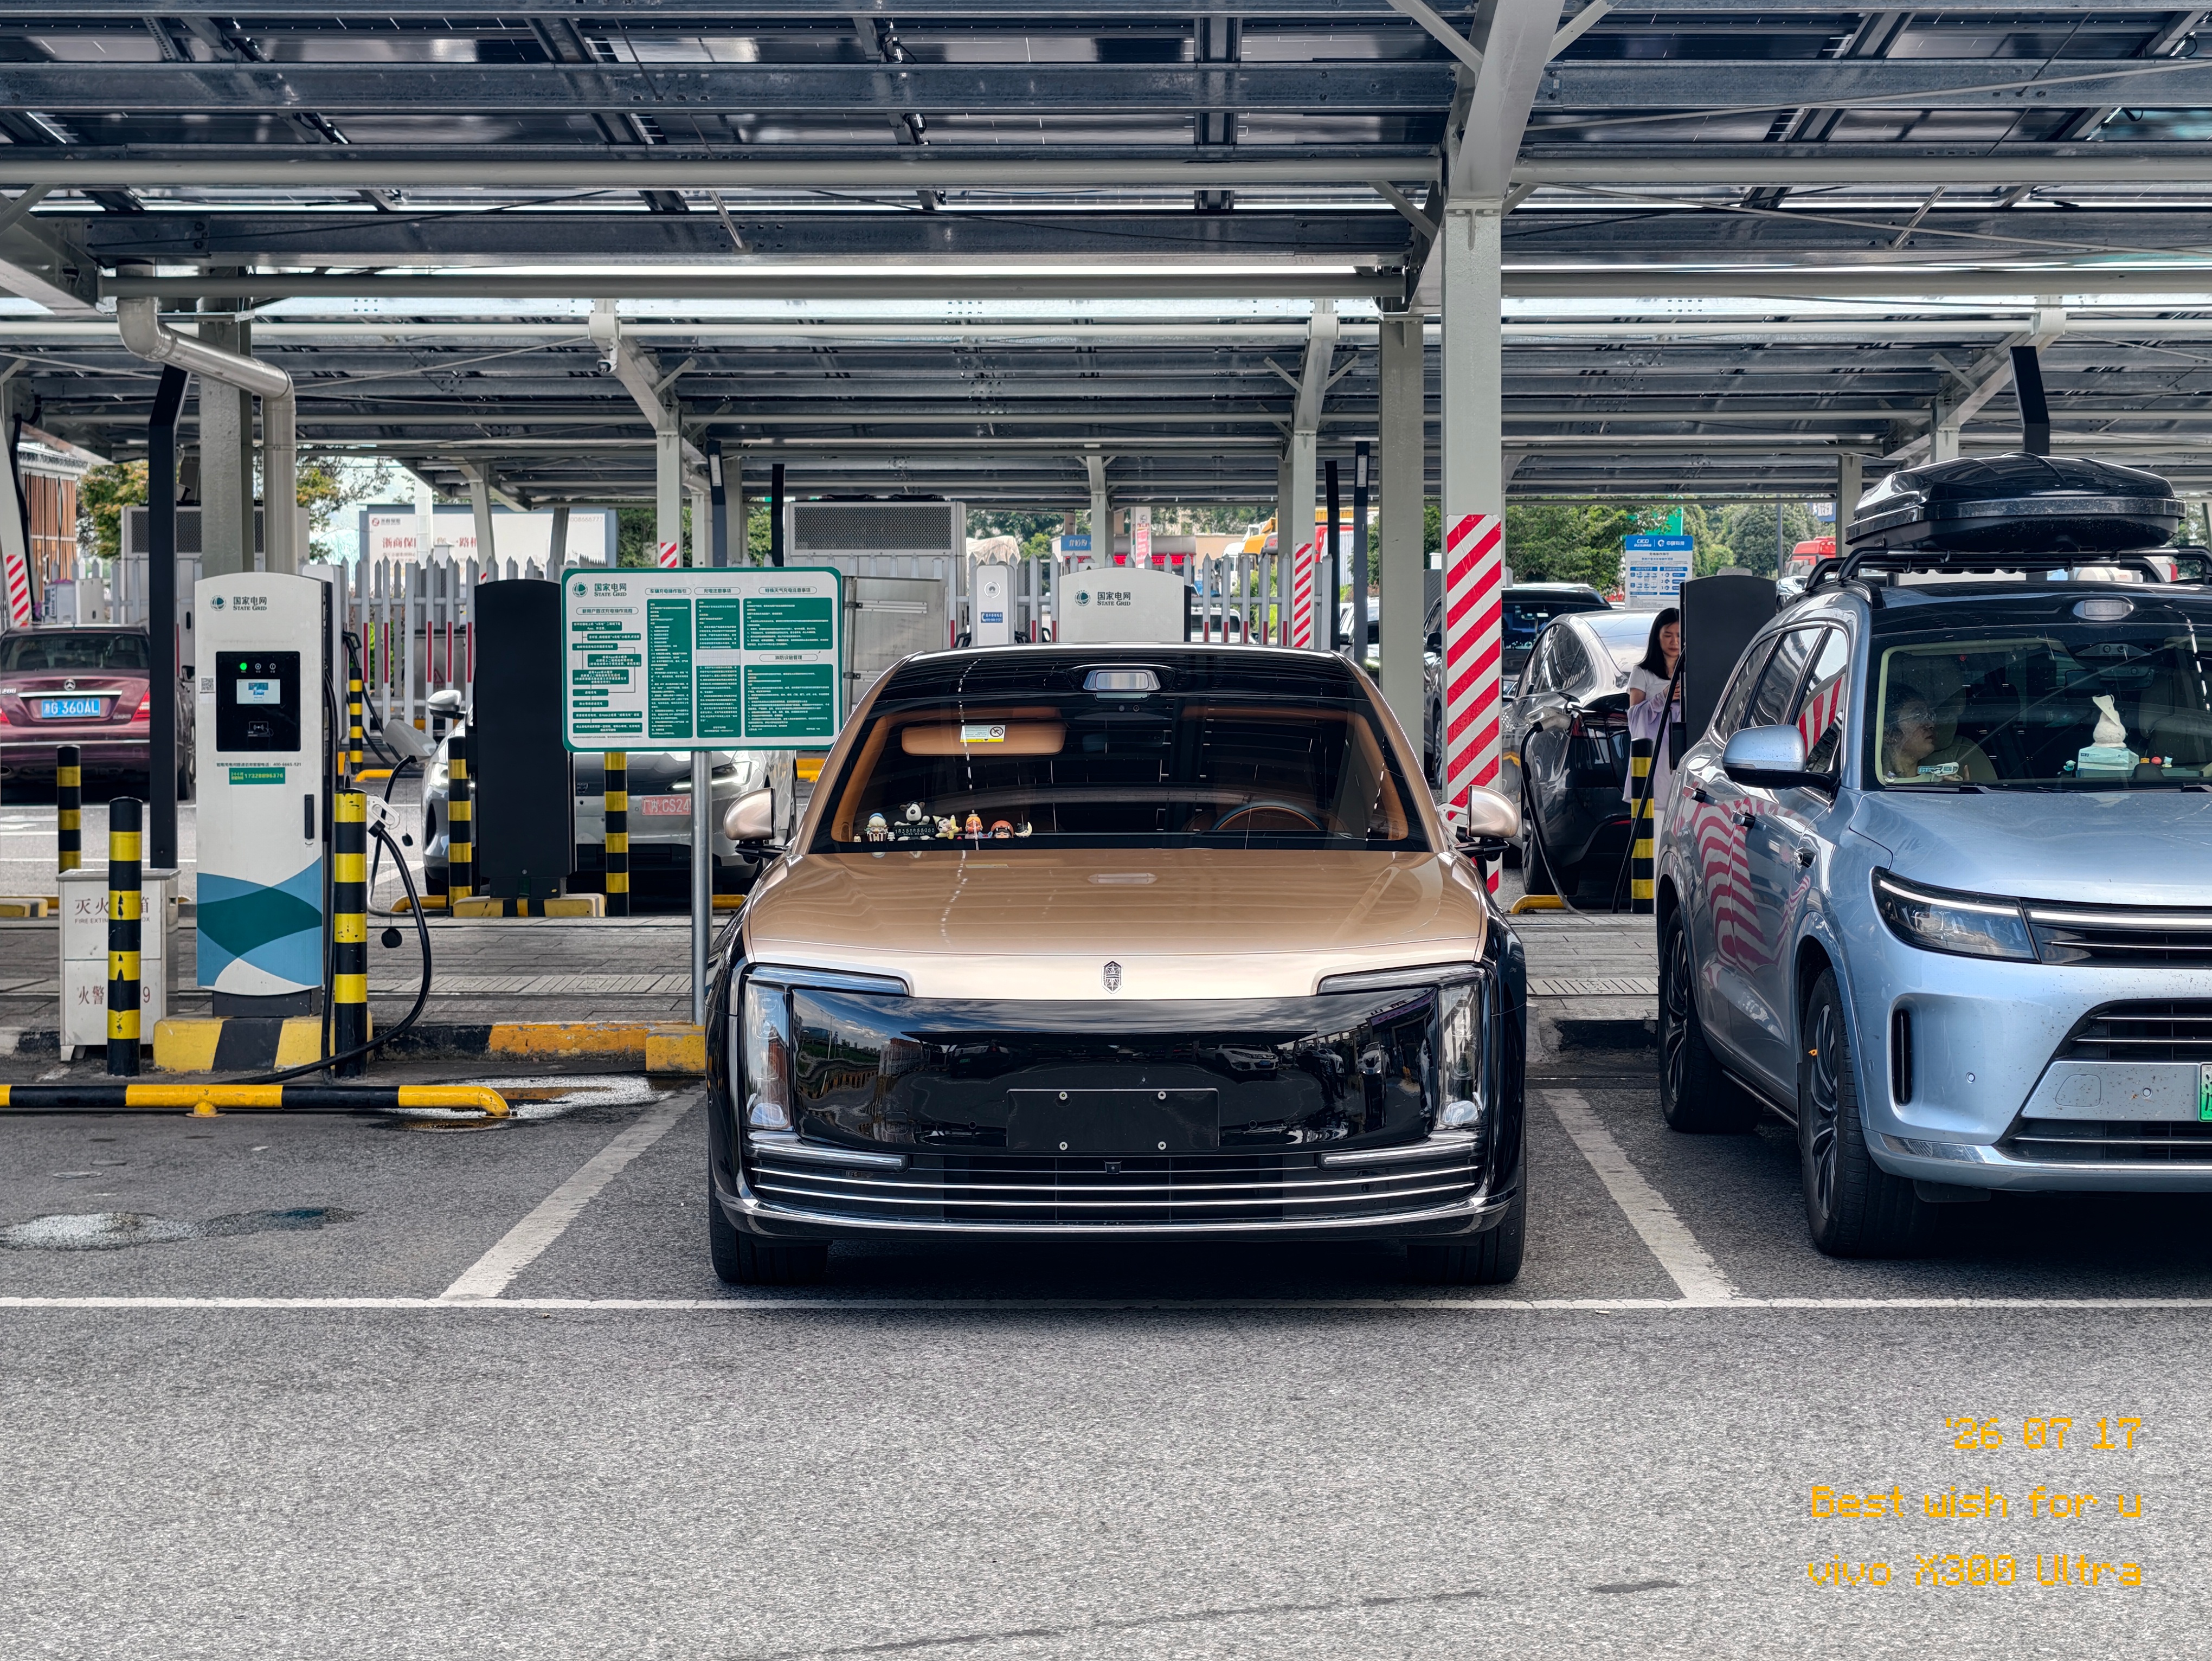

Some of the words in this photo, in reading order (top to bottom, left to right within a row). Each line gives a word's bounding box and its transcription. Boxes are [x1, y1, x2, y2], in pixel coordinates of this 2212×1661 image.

[594, 583, 627, 591] 国家电网
[1097, 591, 1131, 600] 国家电网
[233, 596, 267, 606] 国家电网
[662, 798, 691, 813] CS24
